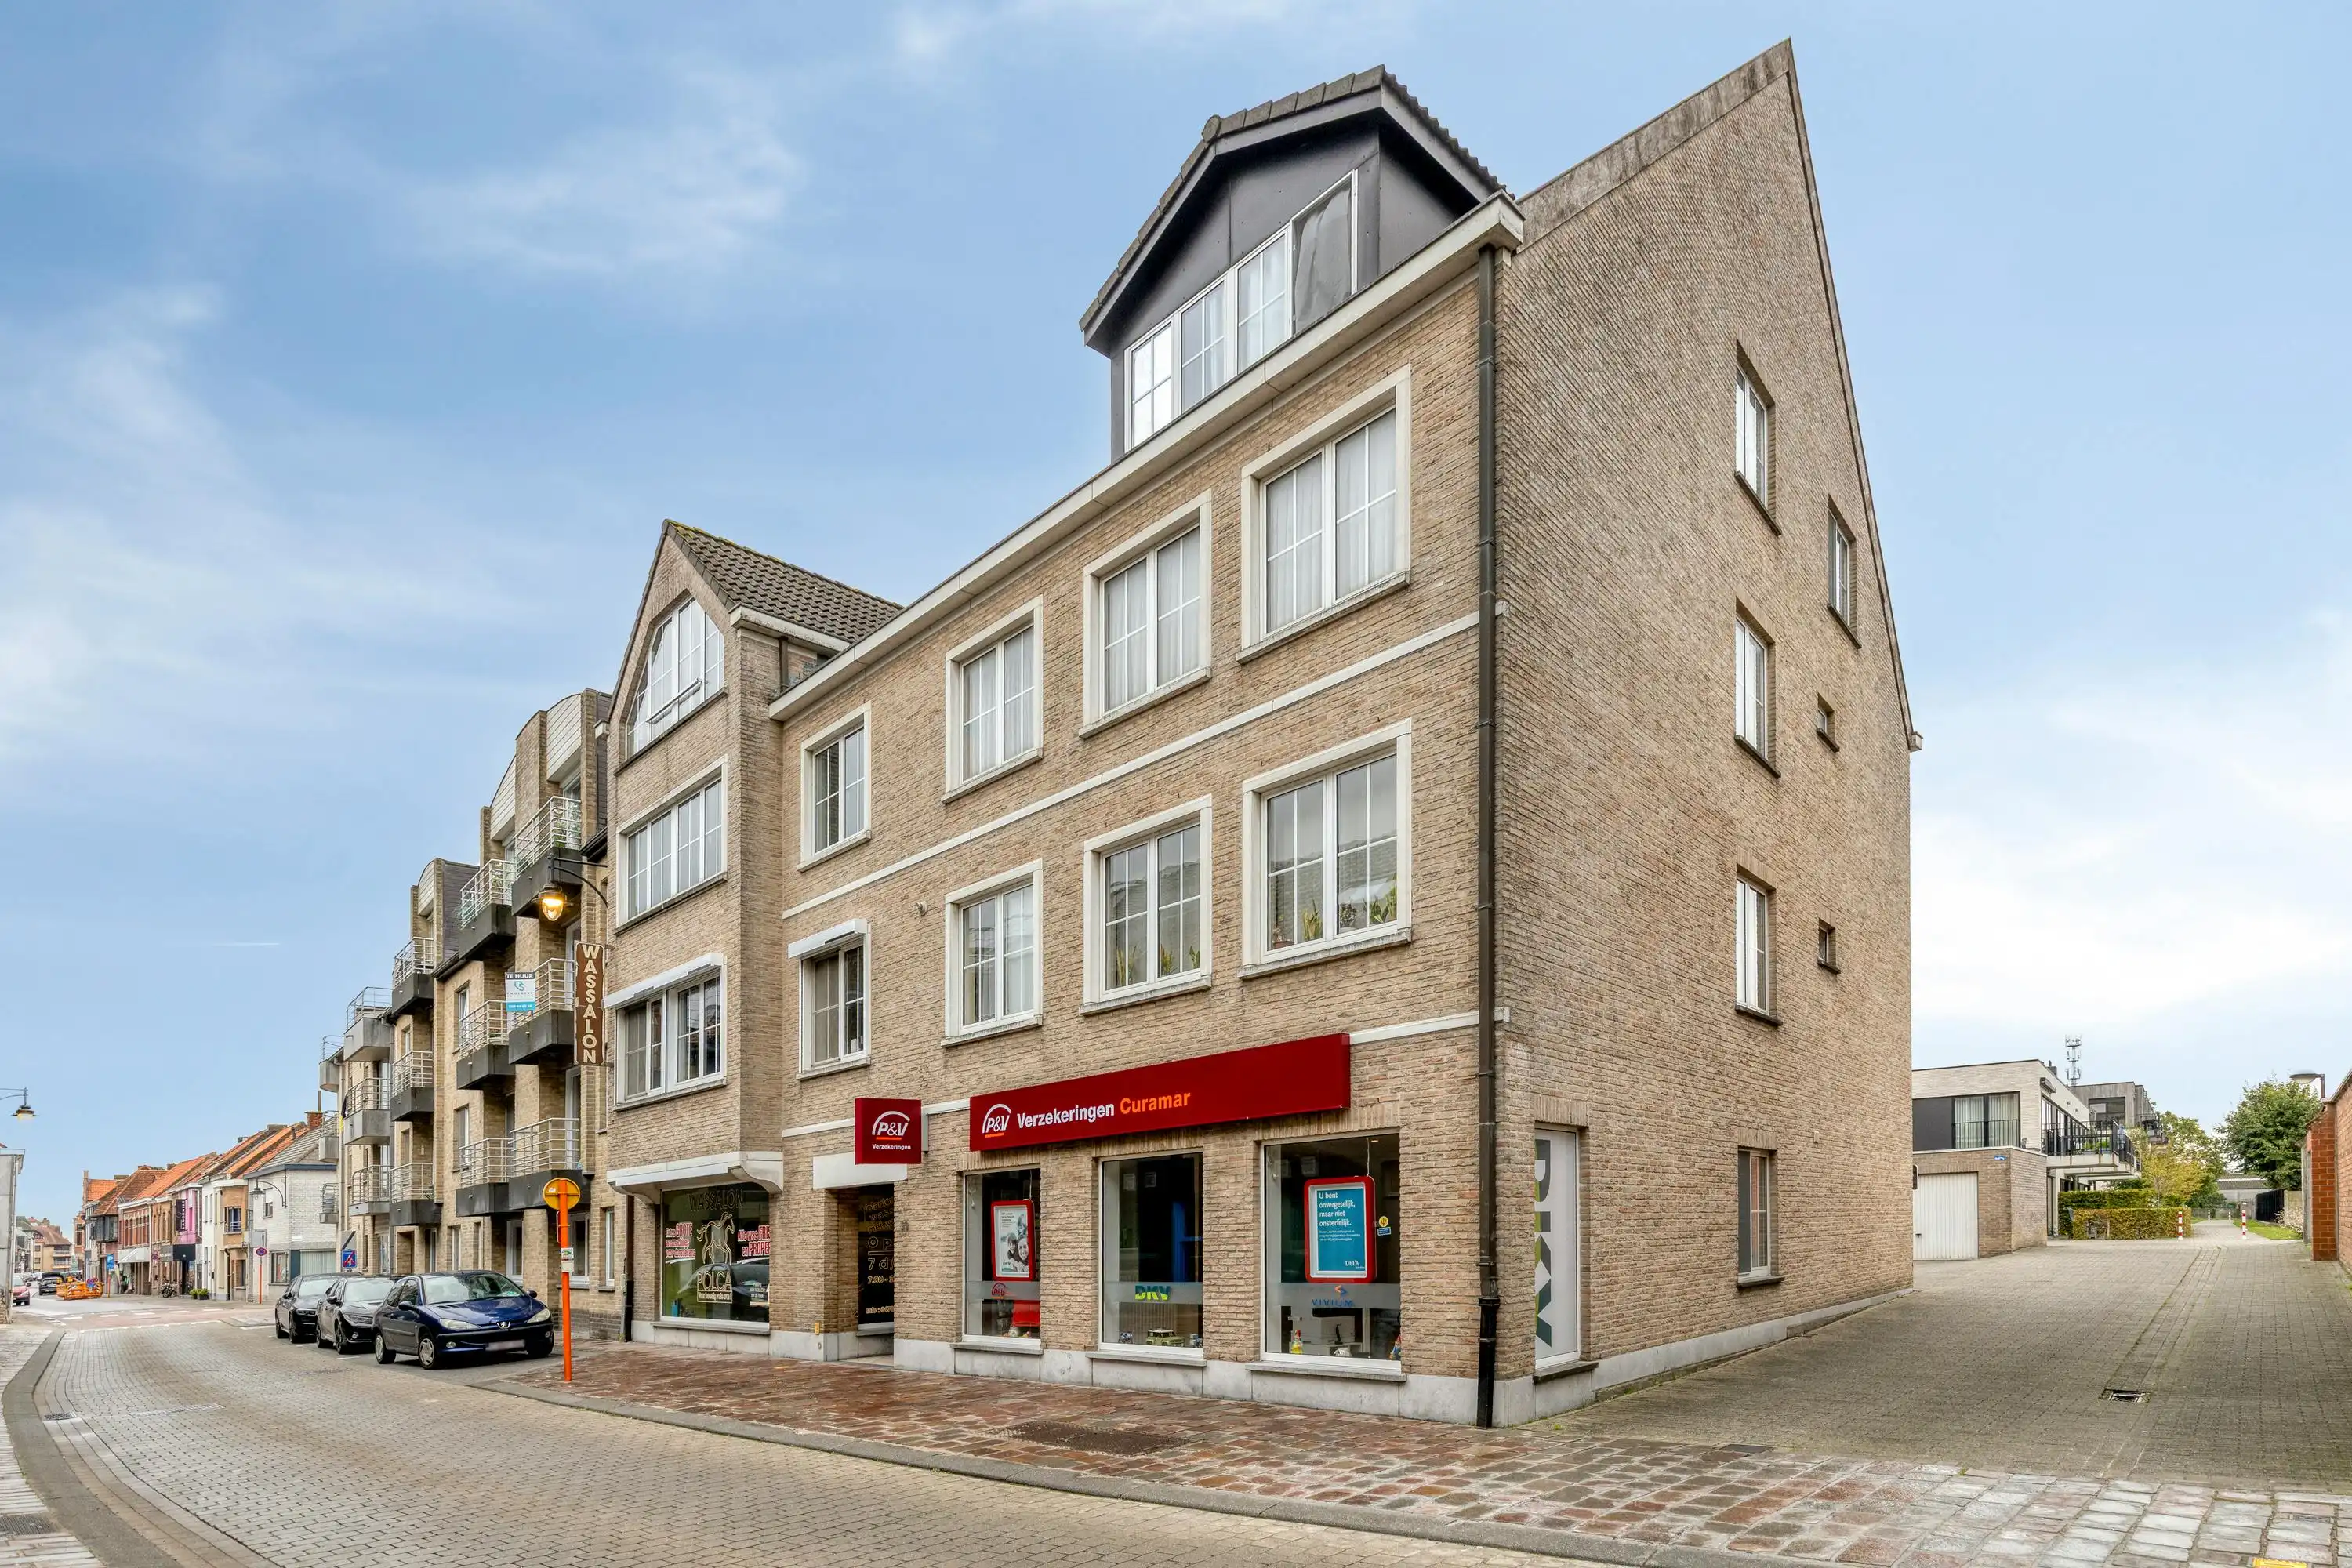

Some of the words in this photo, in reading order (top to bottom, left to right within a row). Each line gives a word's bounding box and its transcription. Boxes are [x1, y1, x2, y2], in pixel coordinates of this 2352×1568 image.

[582, 944, 600, 1064] WASSALON
[986, 1114, 1011, 1134] P&V
[1017, 1103, 1115, 1129] Verzekeringen
[1120, 1092, 1191, 1115] Curamar
[877, 1121, 909, 1136] P&V
[688, 1189, 745, 1211] WASSALON
[1319, 1200, 1356, 1210] onvergetelijk,
[676, 1223, 693, 1236] GROTE
[1319, 1218, 1352, 1228] onsterfelijk.
[738, 1229, 747, 1241] Alle
[747, 1230, 758, 1241] was
[741, 1246, 749, 1257] en
[867, 1257, 876, 1271] 7
[697, 1270, 731, 1292] POLCA
[867, 1275, 884, 1284] 7.00
[1135, 1285, 1171, 1301] DKV
[1311, 1298, 1354, 1307] VIVIUM
